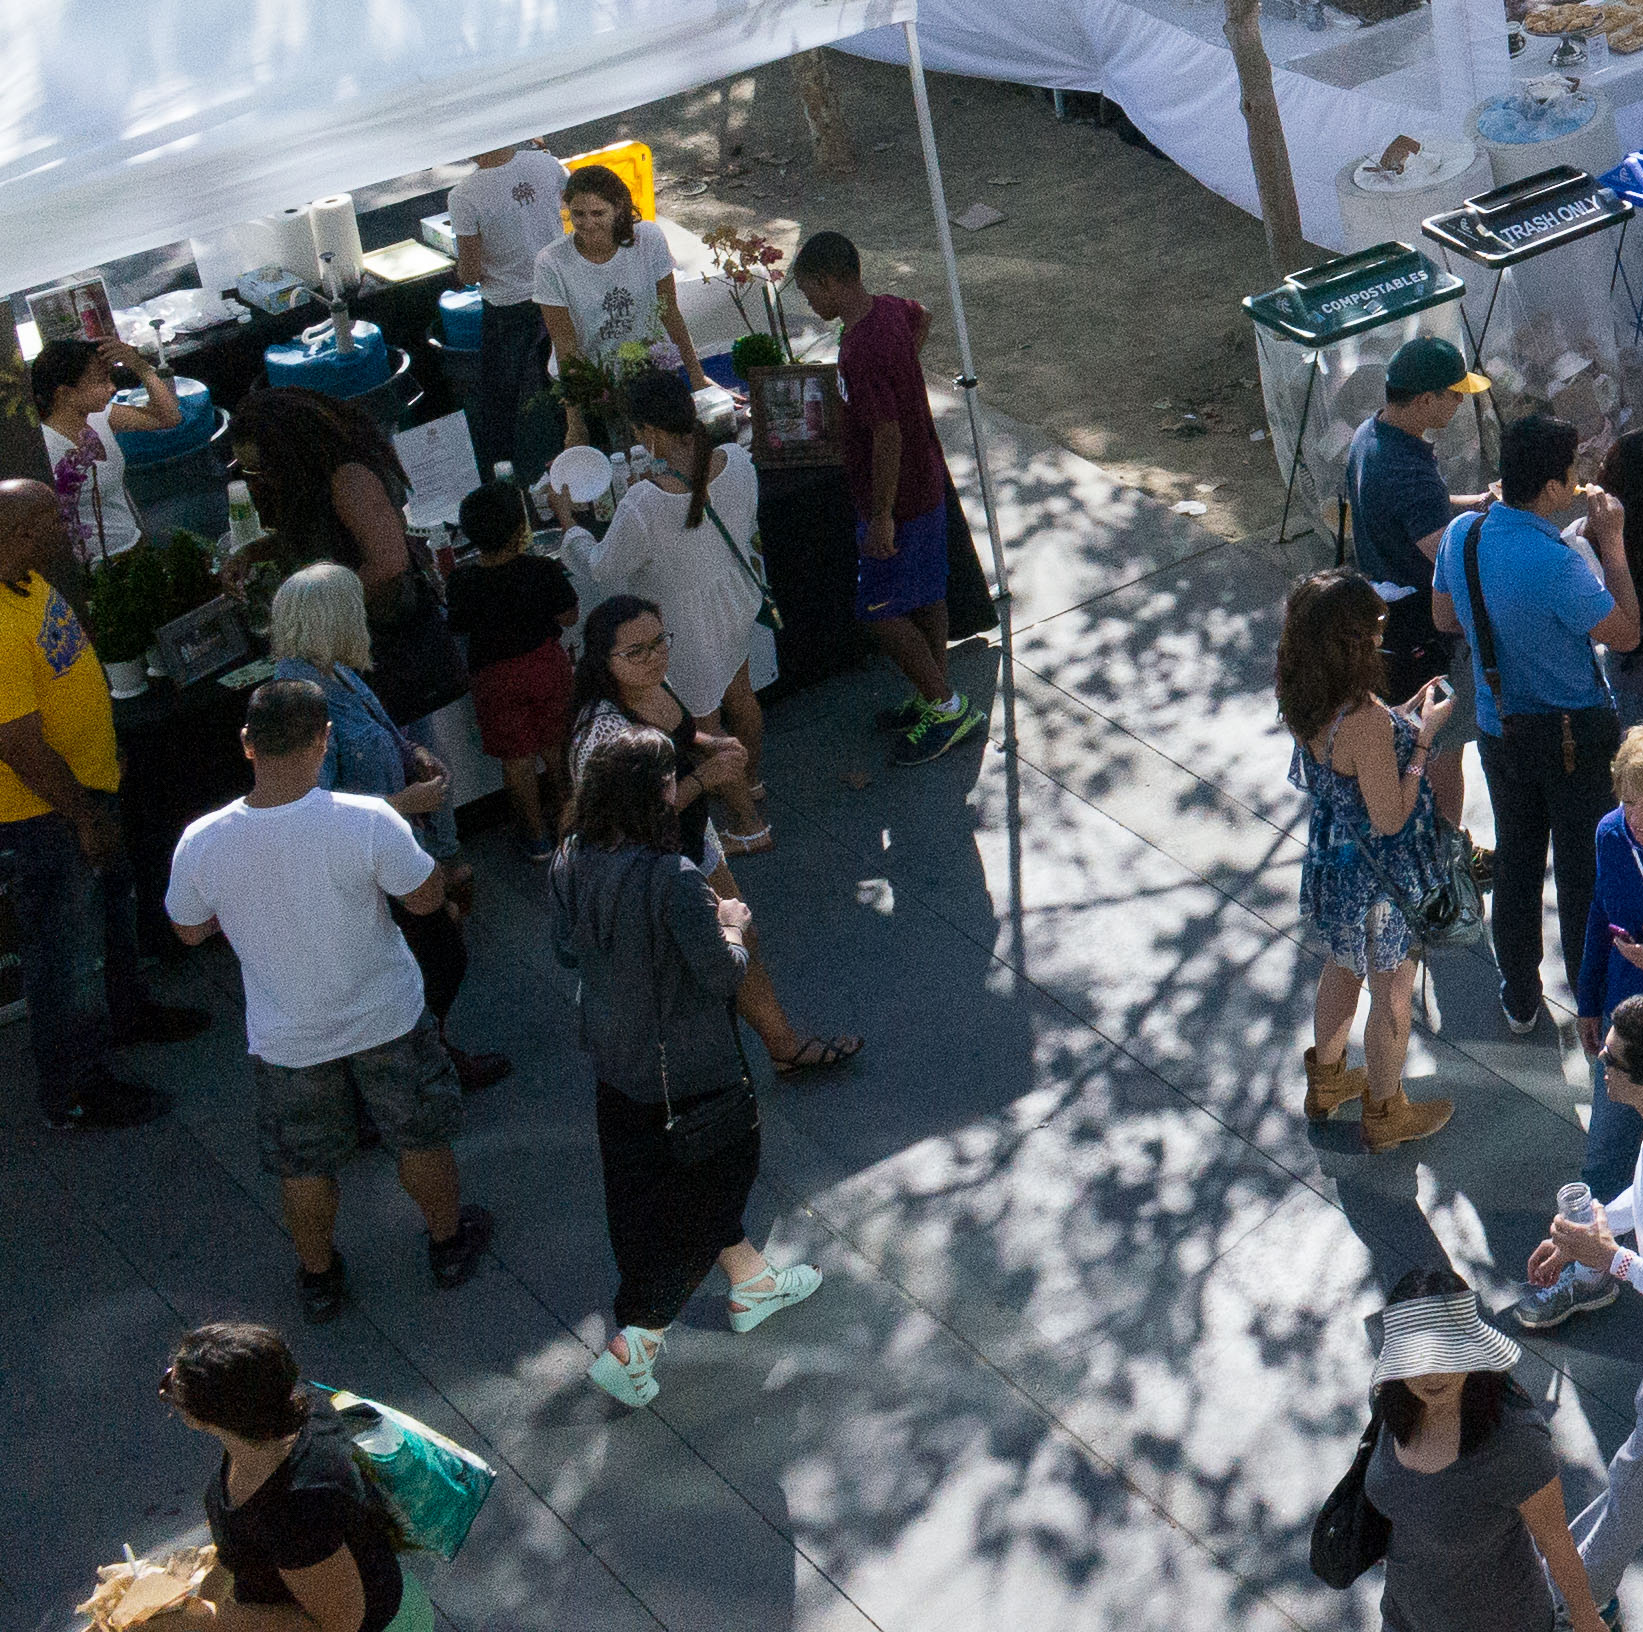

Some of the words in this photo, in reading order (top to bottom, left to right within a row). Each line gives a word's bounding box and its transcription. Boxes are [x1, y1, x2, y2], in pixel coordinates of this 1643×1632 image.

[1500, 211, 1561, 243] TRASH
[1557, 194, 1602, 222] ONLY
[1321, 269, 1429, 314] COMPOSTABLES
